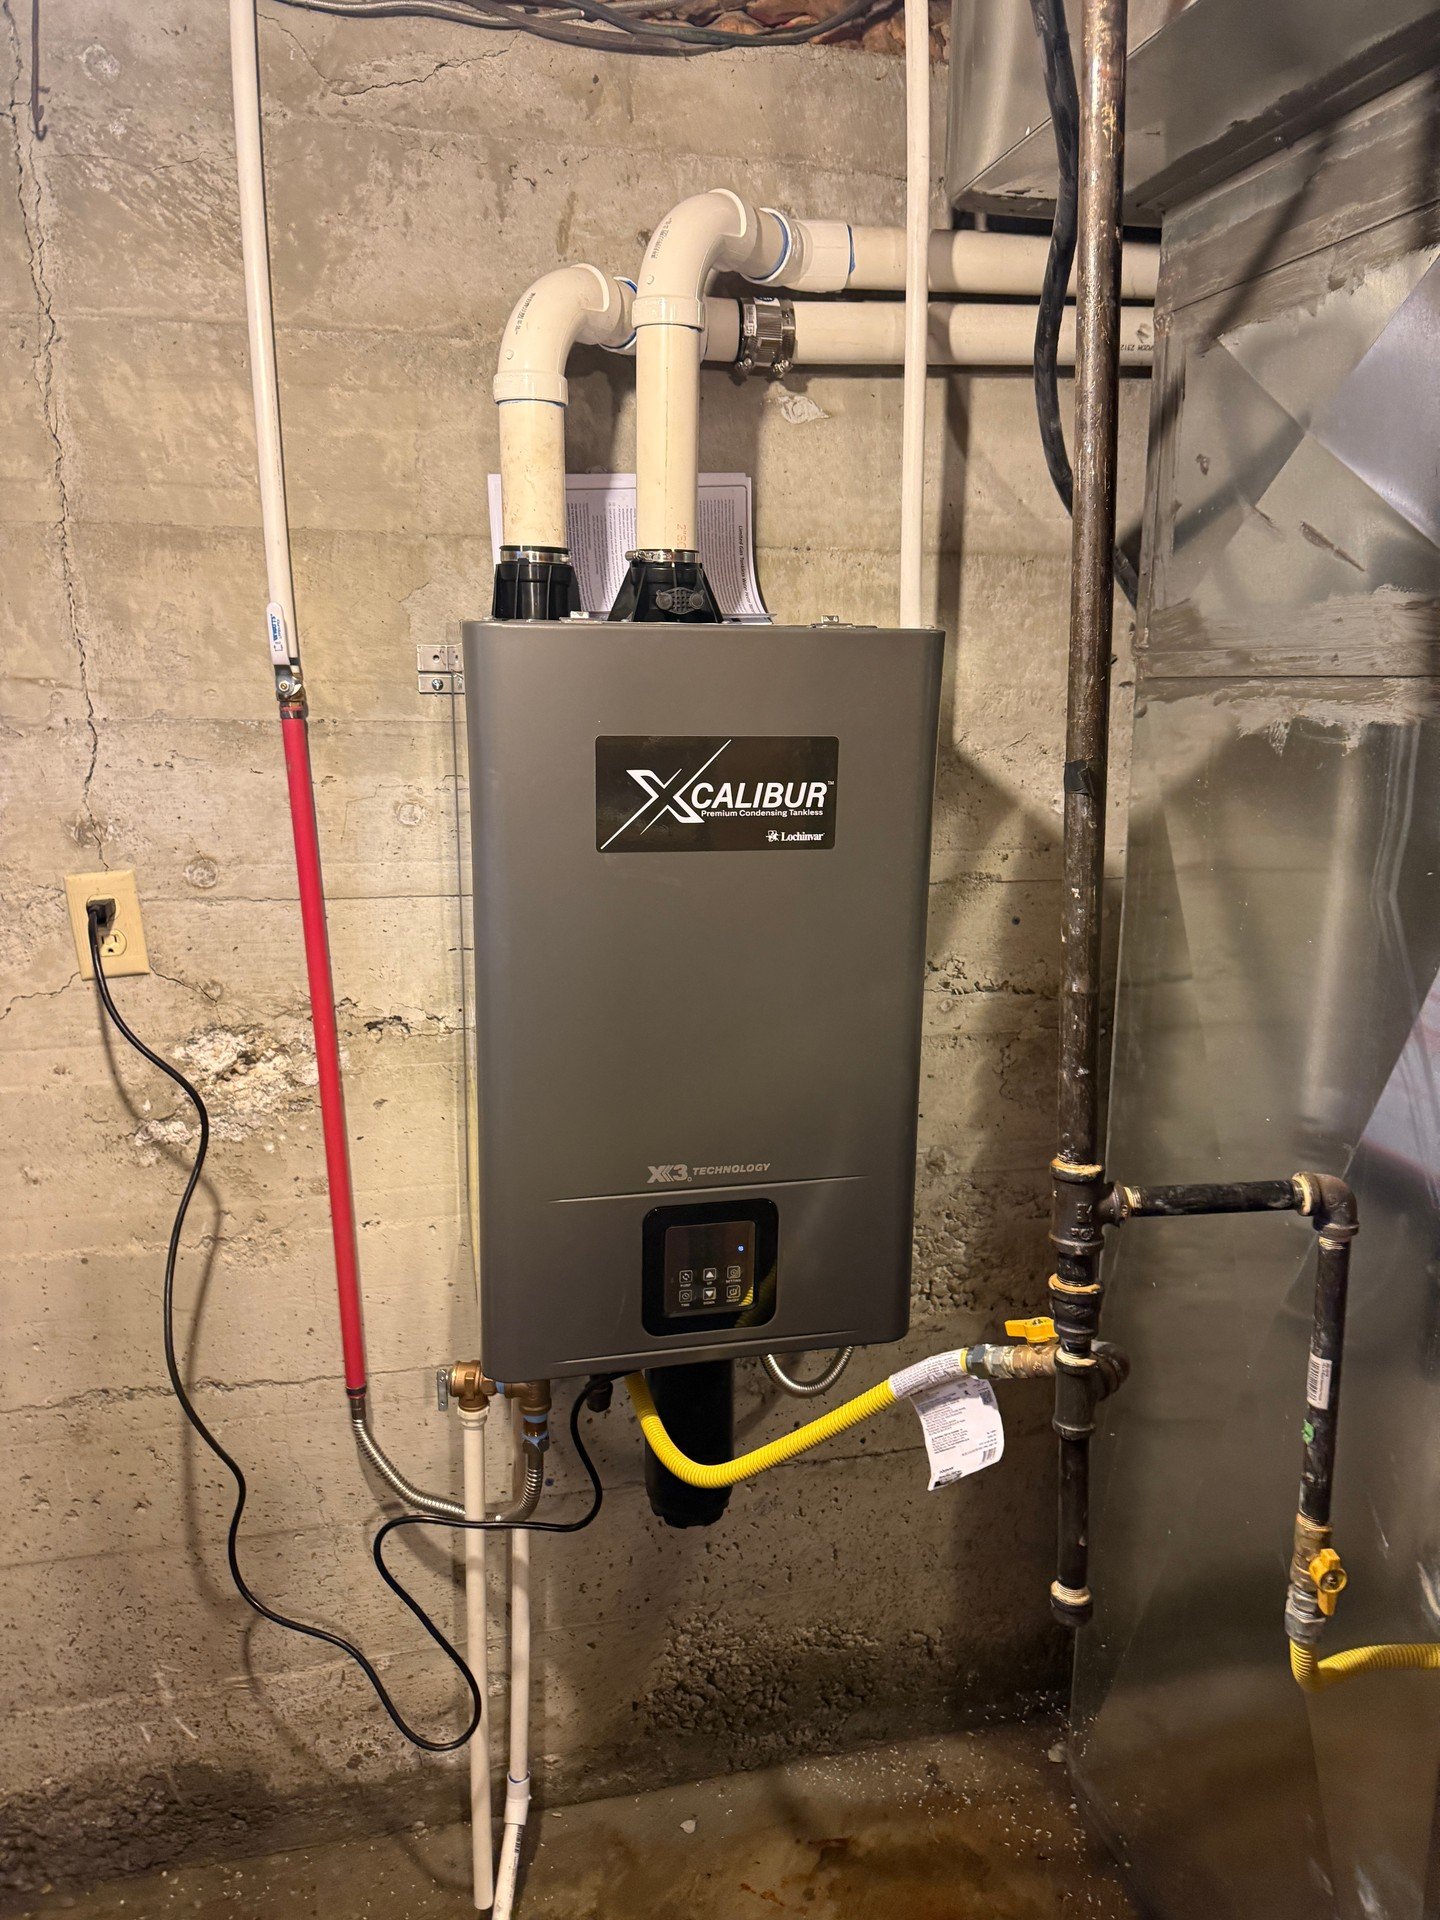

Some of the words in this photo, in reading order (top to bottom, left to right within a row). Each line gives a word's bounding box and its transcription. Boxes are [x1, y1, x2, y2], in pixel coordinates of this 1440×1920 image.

[701, 809, 738, 817] Premium
[739, 809, 788, 818] Condensing
[788, 808, 824, 816] Tankless
[780, 831, 823, 842] Lochinvar
[692, 1162, 771, 1176] TECHNOLOGY
